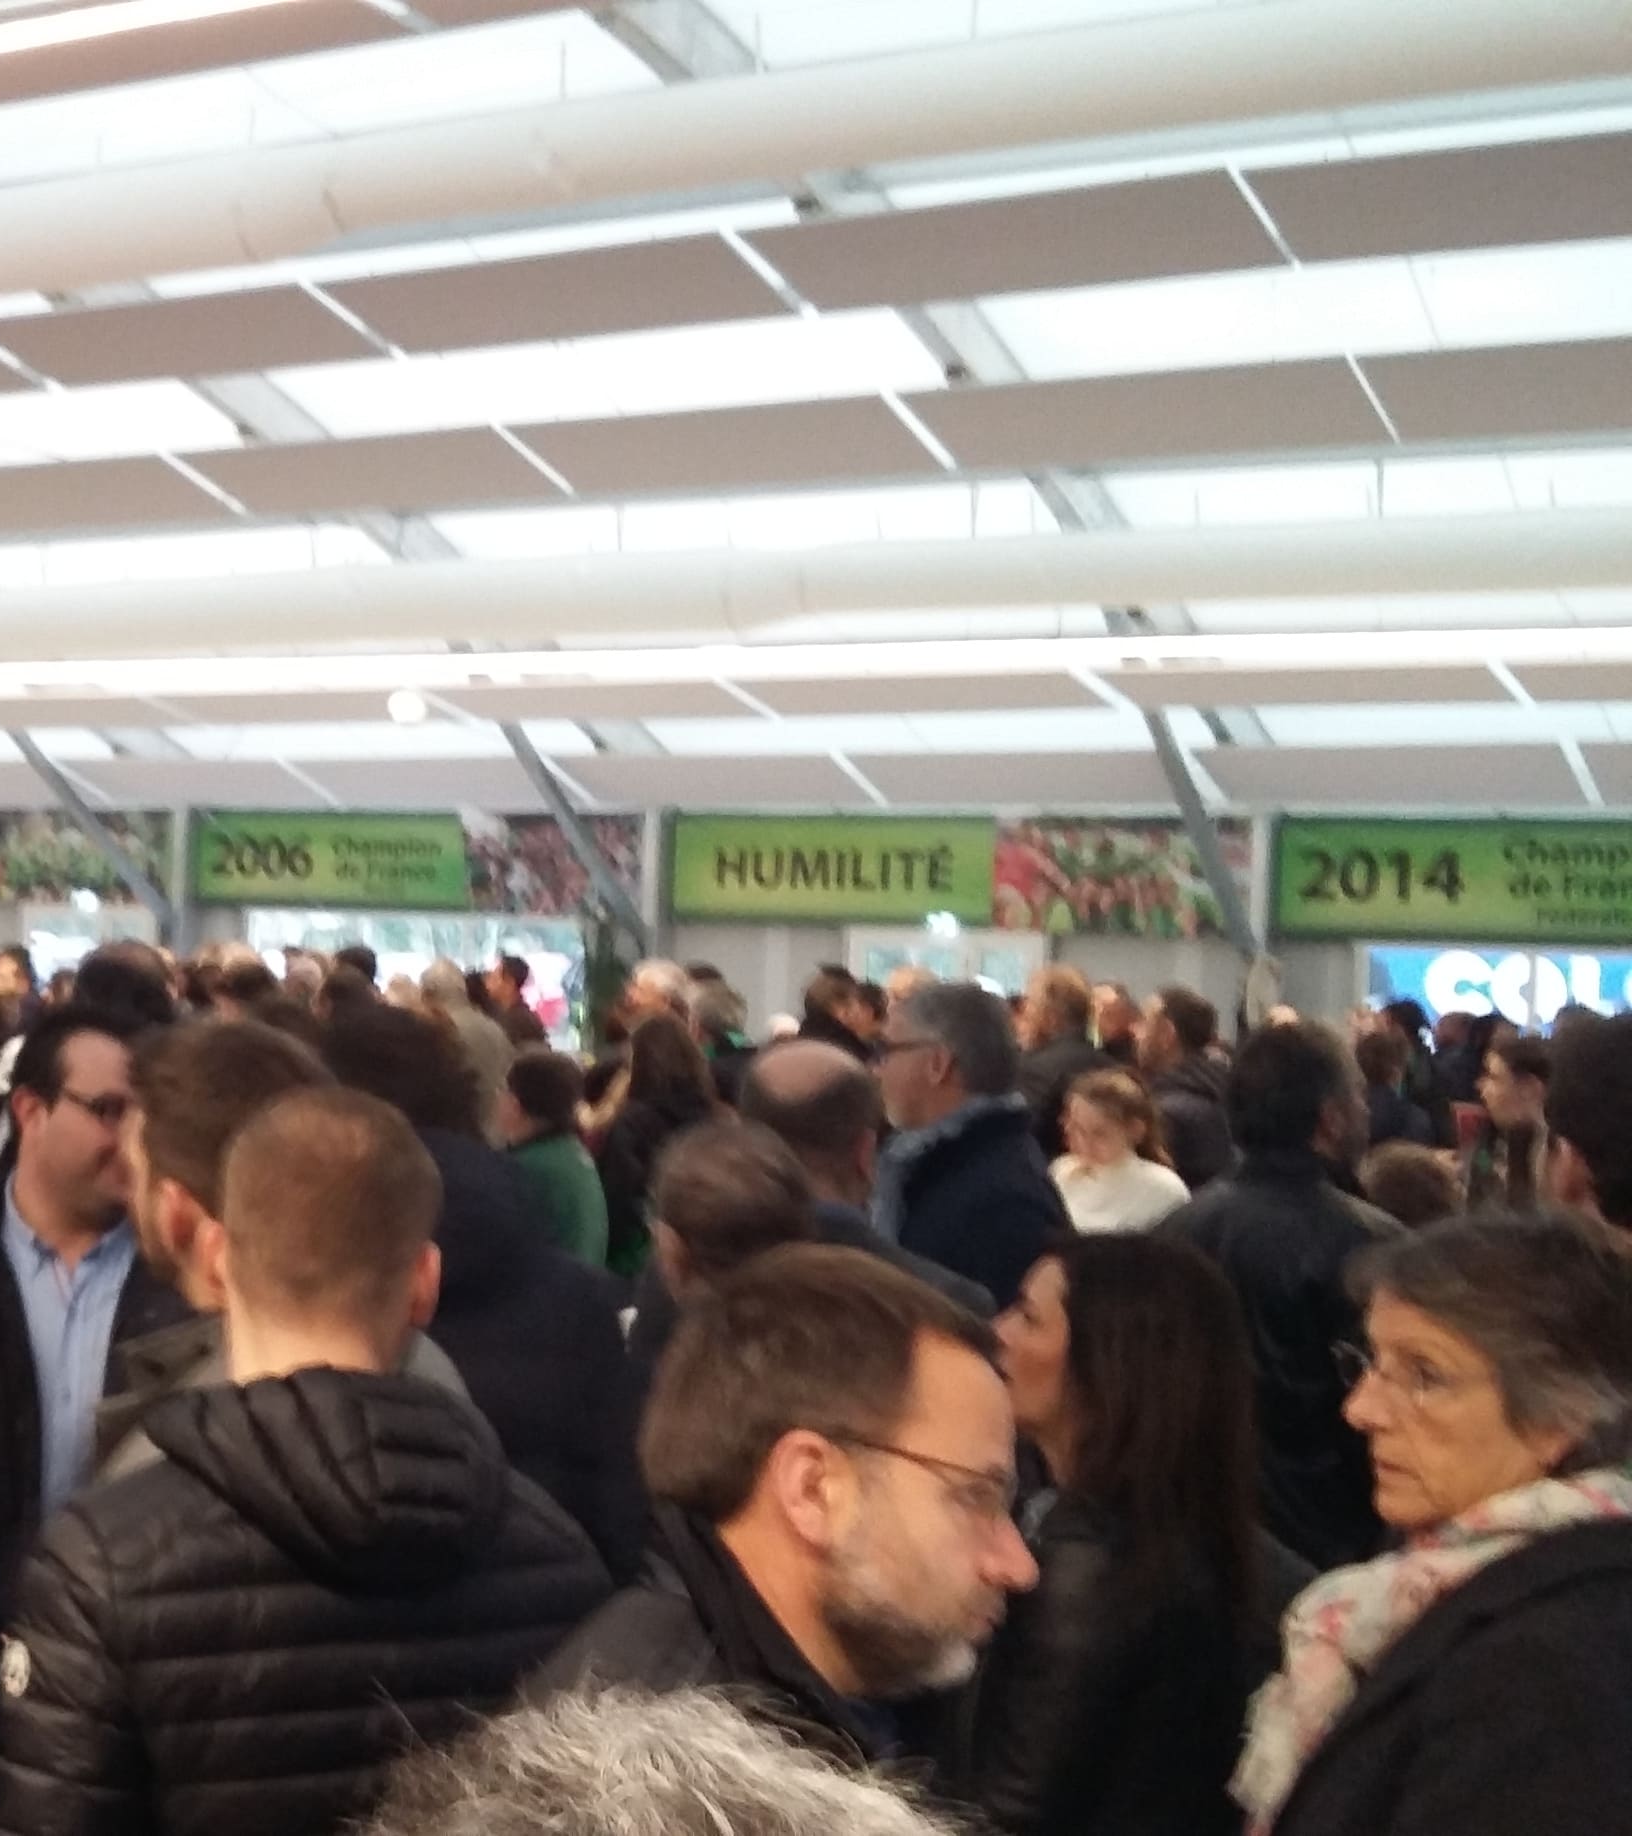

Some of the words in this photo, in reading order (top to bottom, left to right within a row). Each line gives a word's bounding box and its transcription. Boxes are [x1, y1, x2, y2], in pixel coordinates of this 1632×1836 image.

[210, 831, 314, 881] 2006
[714, 842, 954, 890] HUMILITÉ
[1299, 848, 1465, 903] 2014
[1508, 872, 1553, 899] de
